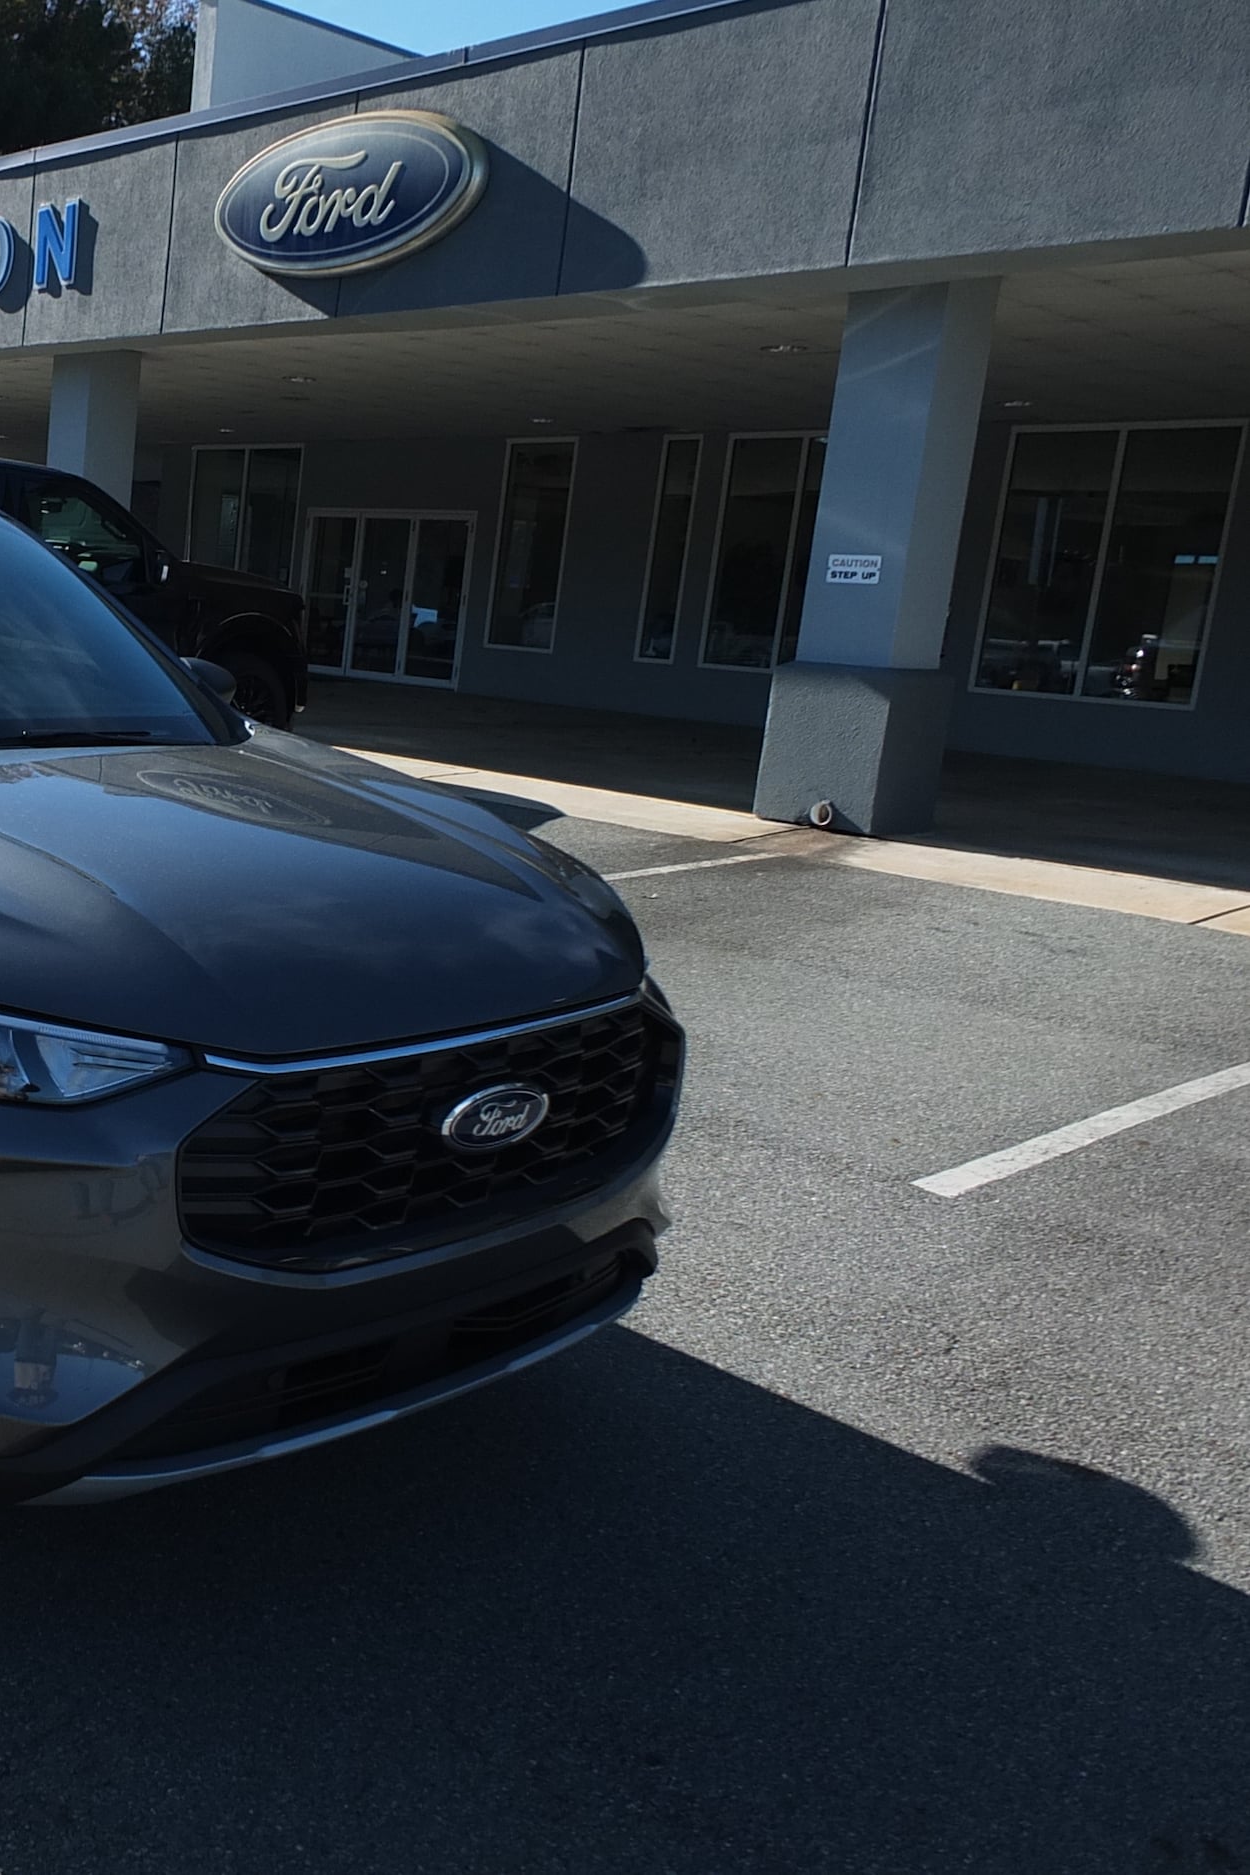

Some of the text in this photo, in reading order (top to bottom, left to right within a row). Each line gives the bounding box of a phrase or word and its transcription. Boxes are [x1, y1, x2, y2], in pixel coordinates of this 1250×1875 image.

[259, 150, 402, 242] Ford
[832, 558, 878, 568] CAUTION
[830, 570, 876, 580] STEP UP
[472, 1100, 530, 1137] Ford
